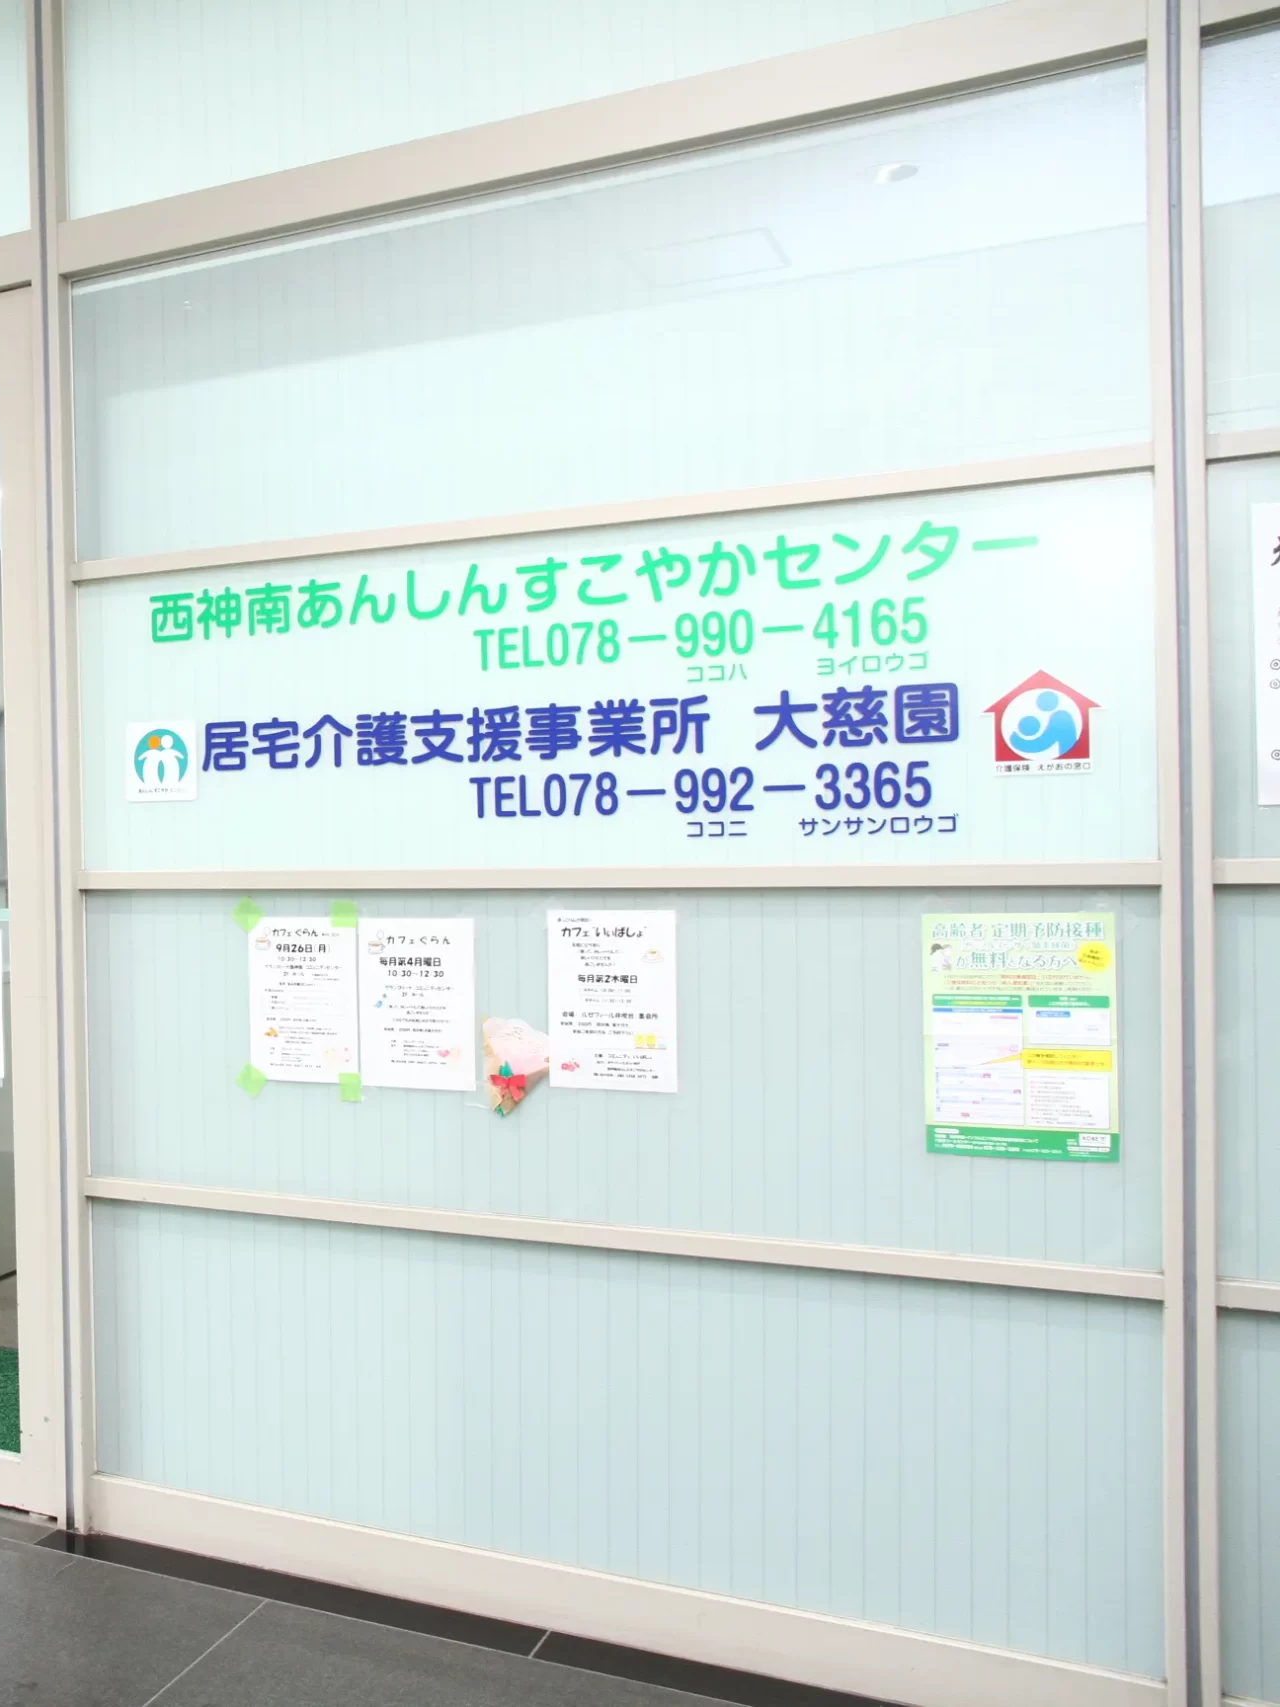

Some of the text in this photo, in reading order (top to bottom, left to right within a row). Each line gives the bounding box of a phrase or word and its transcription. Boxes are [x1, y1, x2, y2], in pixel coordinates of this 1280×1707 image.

[150, 519, 1038, 643] 西神南あんしんすこやかセンター
[688, 663, 747, 682] ココハ
[817, 651, 929, 677] ヨイロウゴ
[202, 682, 960, 772] 居宅介護支援事業所 大慈園
[687, 821, 748, 838] ココニ
[799, 813, 959, 837] サンサンロウゴ
[991, 921, 1105, 938] 定期予防接種
[379, 956, 442, 967] 毎月第4月曜日
[577, 974, 638, 984] 毎月第2木曜日
